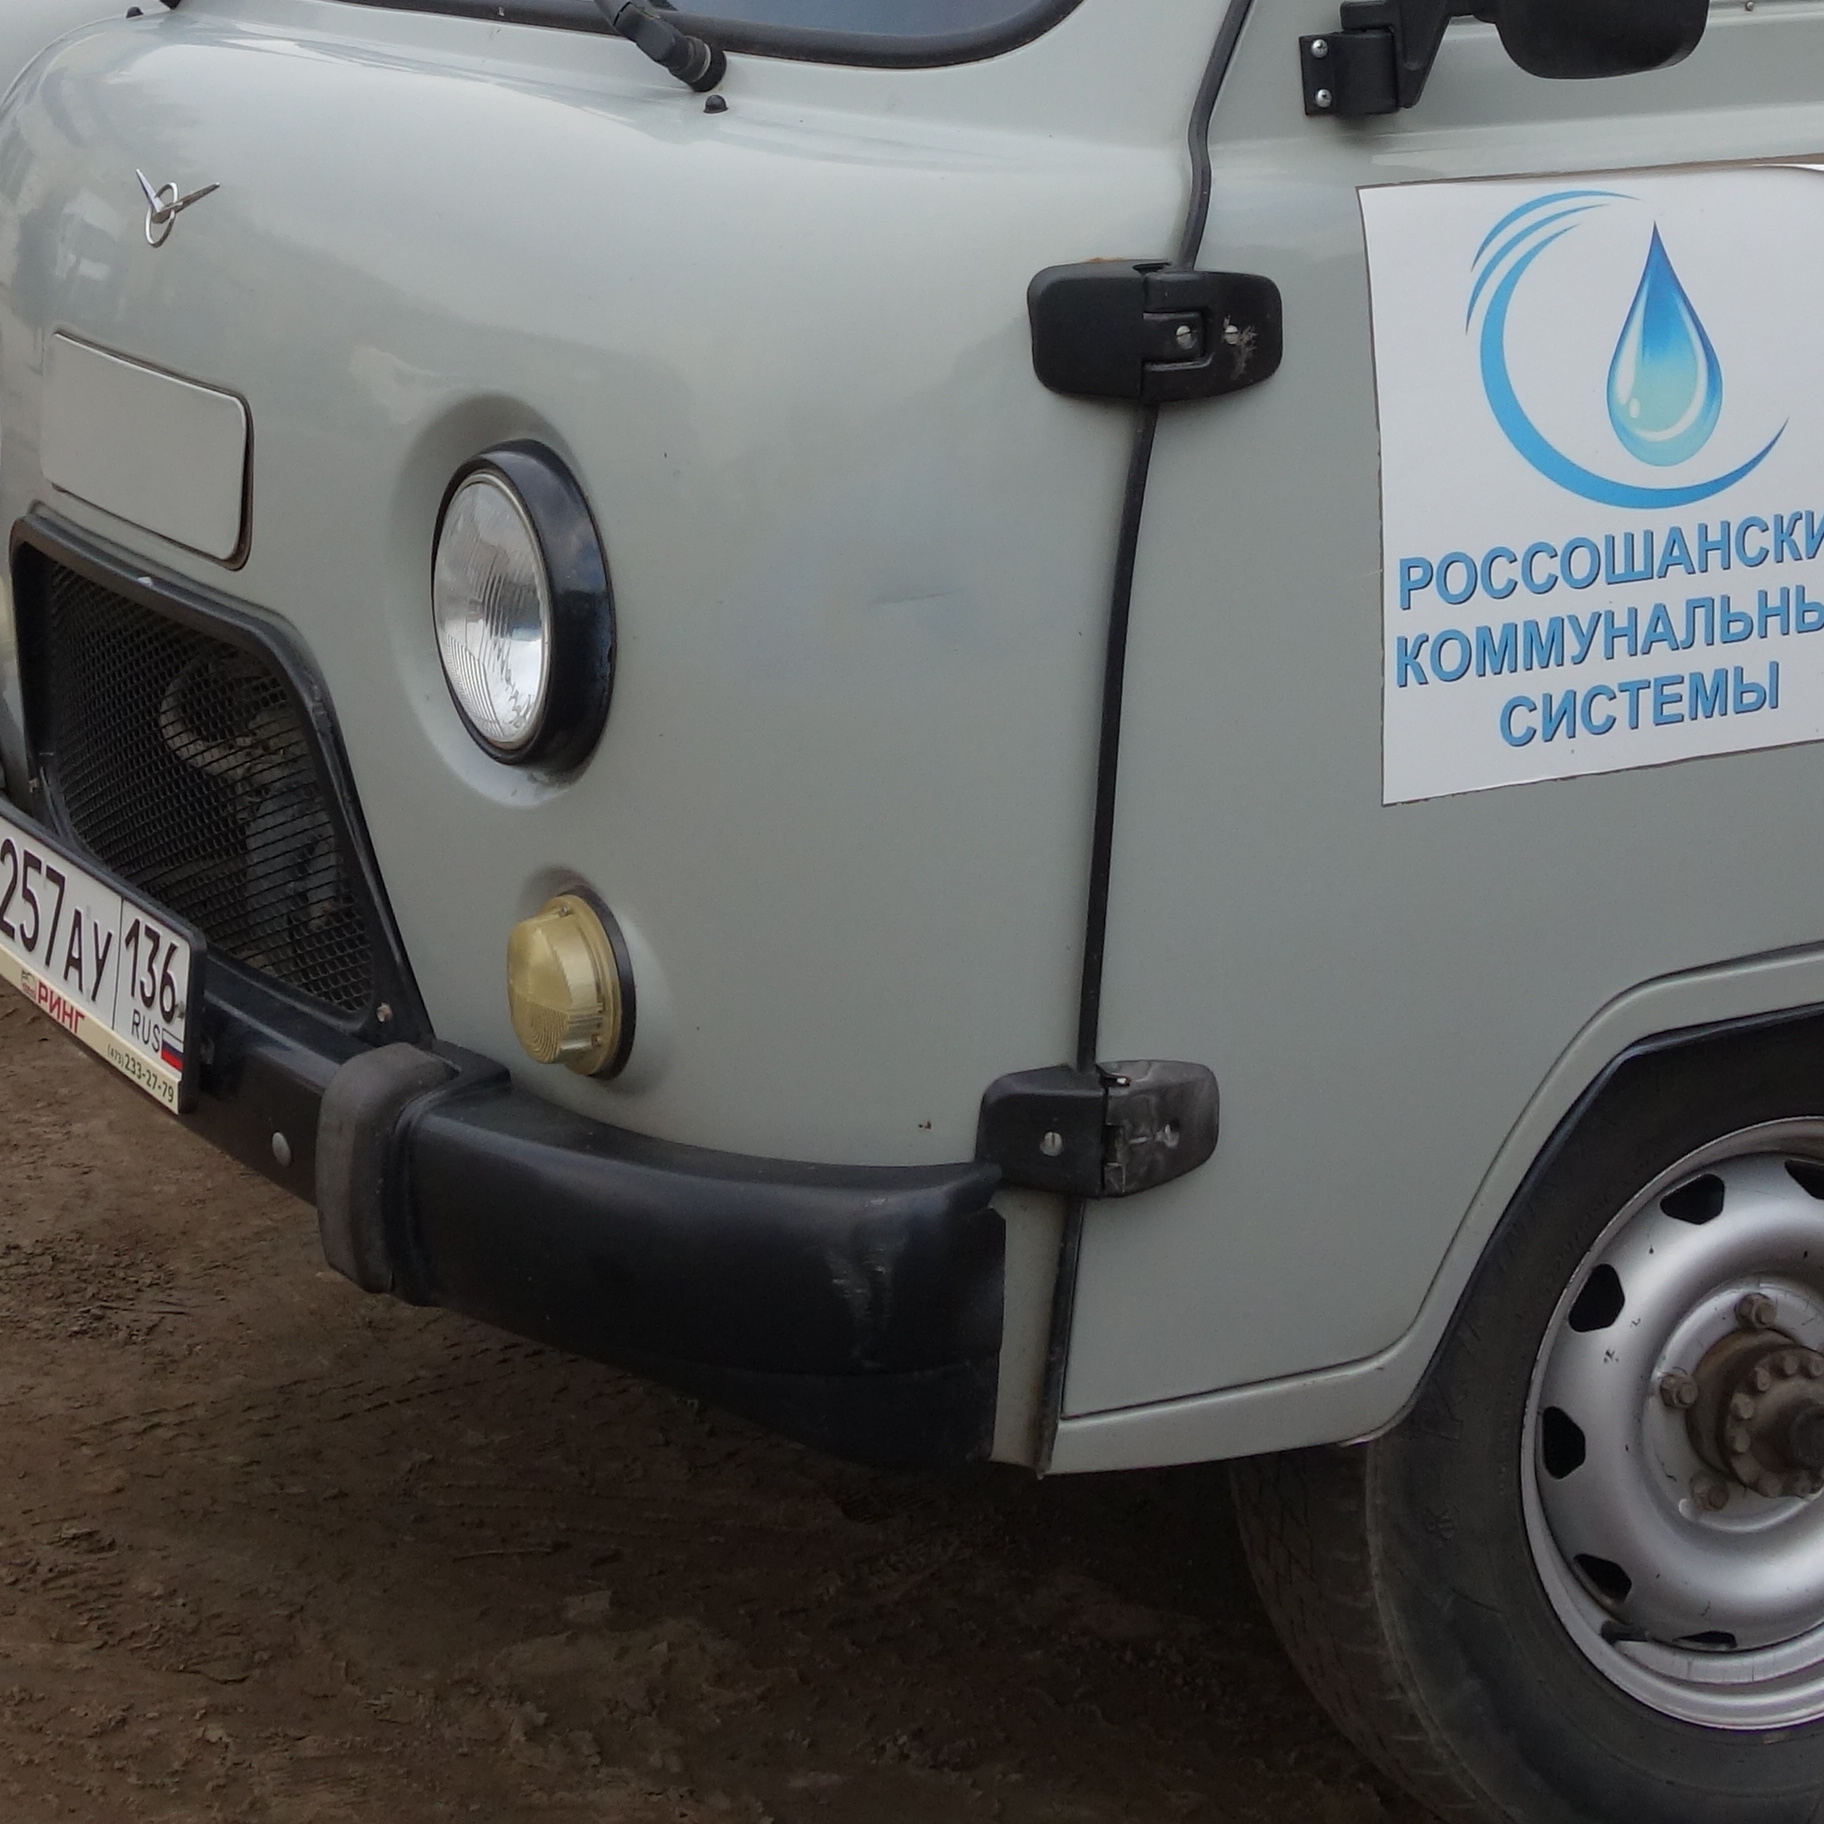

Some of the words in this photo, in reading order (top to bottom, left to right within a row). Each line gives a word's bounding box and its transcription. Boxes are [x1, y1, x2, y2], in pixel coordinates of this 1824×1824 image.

[1498, 662, 1780, 747] СИСТЕМЫ
[124, 918, 177, 1023] 136
[37, 980, 85, 1034] РИНГ
[131, 1008, 161, 1053] RUS
